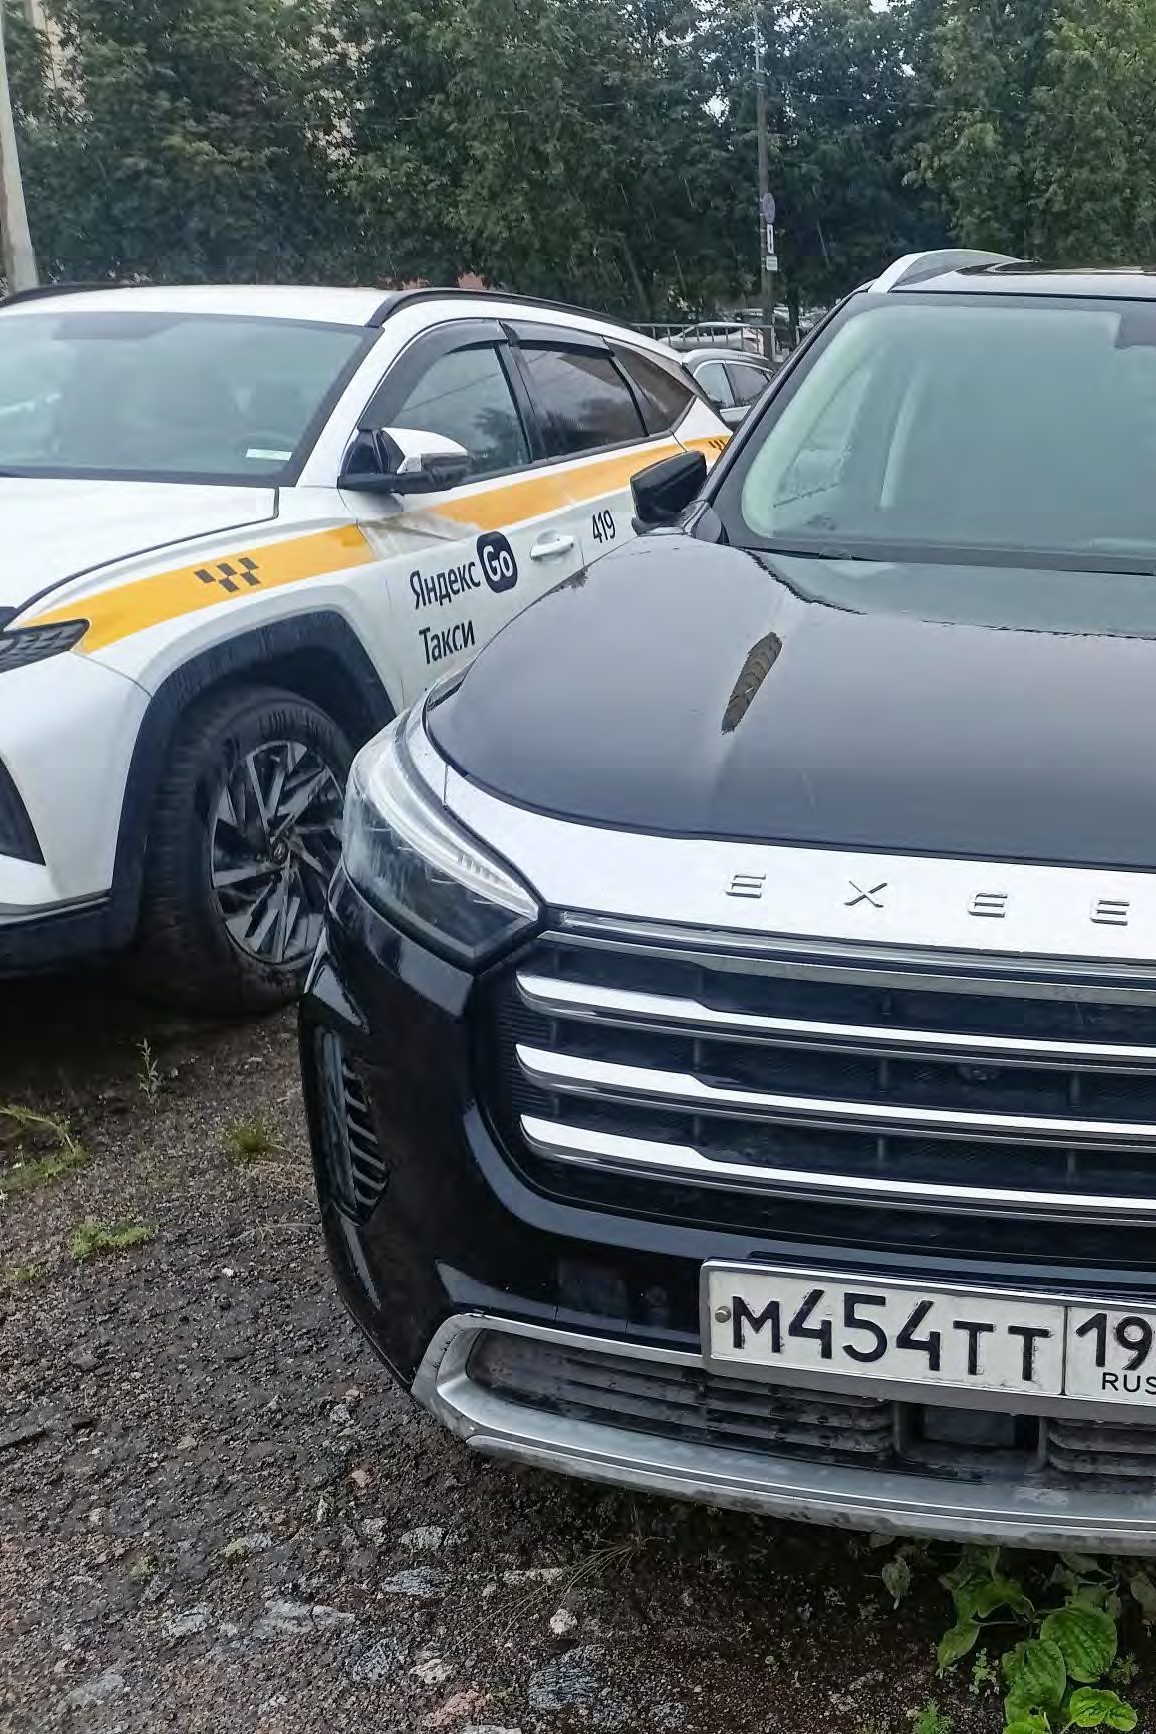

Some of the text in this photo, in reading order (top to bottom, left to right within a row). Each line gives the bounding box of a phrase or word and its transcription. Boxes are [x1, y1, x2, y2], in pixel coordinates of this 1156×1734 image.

[592, 509, 616, 543] 419
[410, 545, 515, 610] Яндекс Go
[419, 620, 475, 665] Такси
[731, 1289, 1051, 1381] М454ТТ
